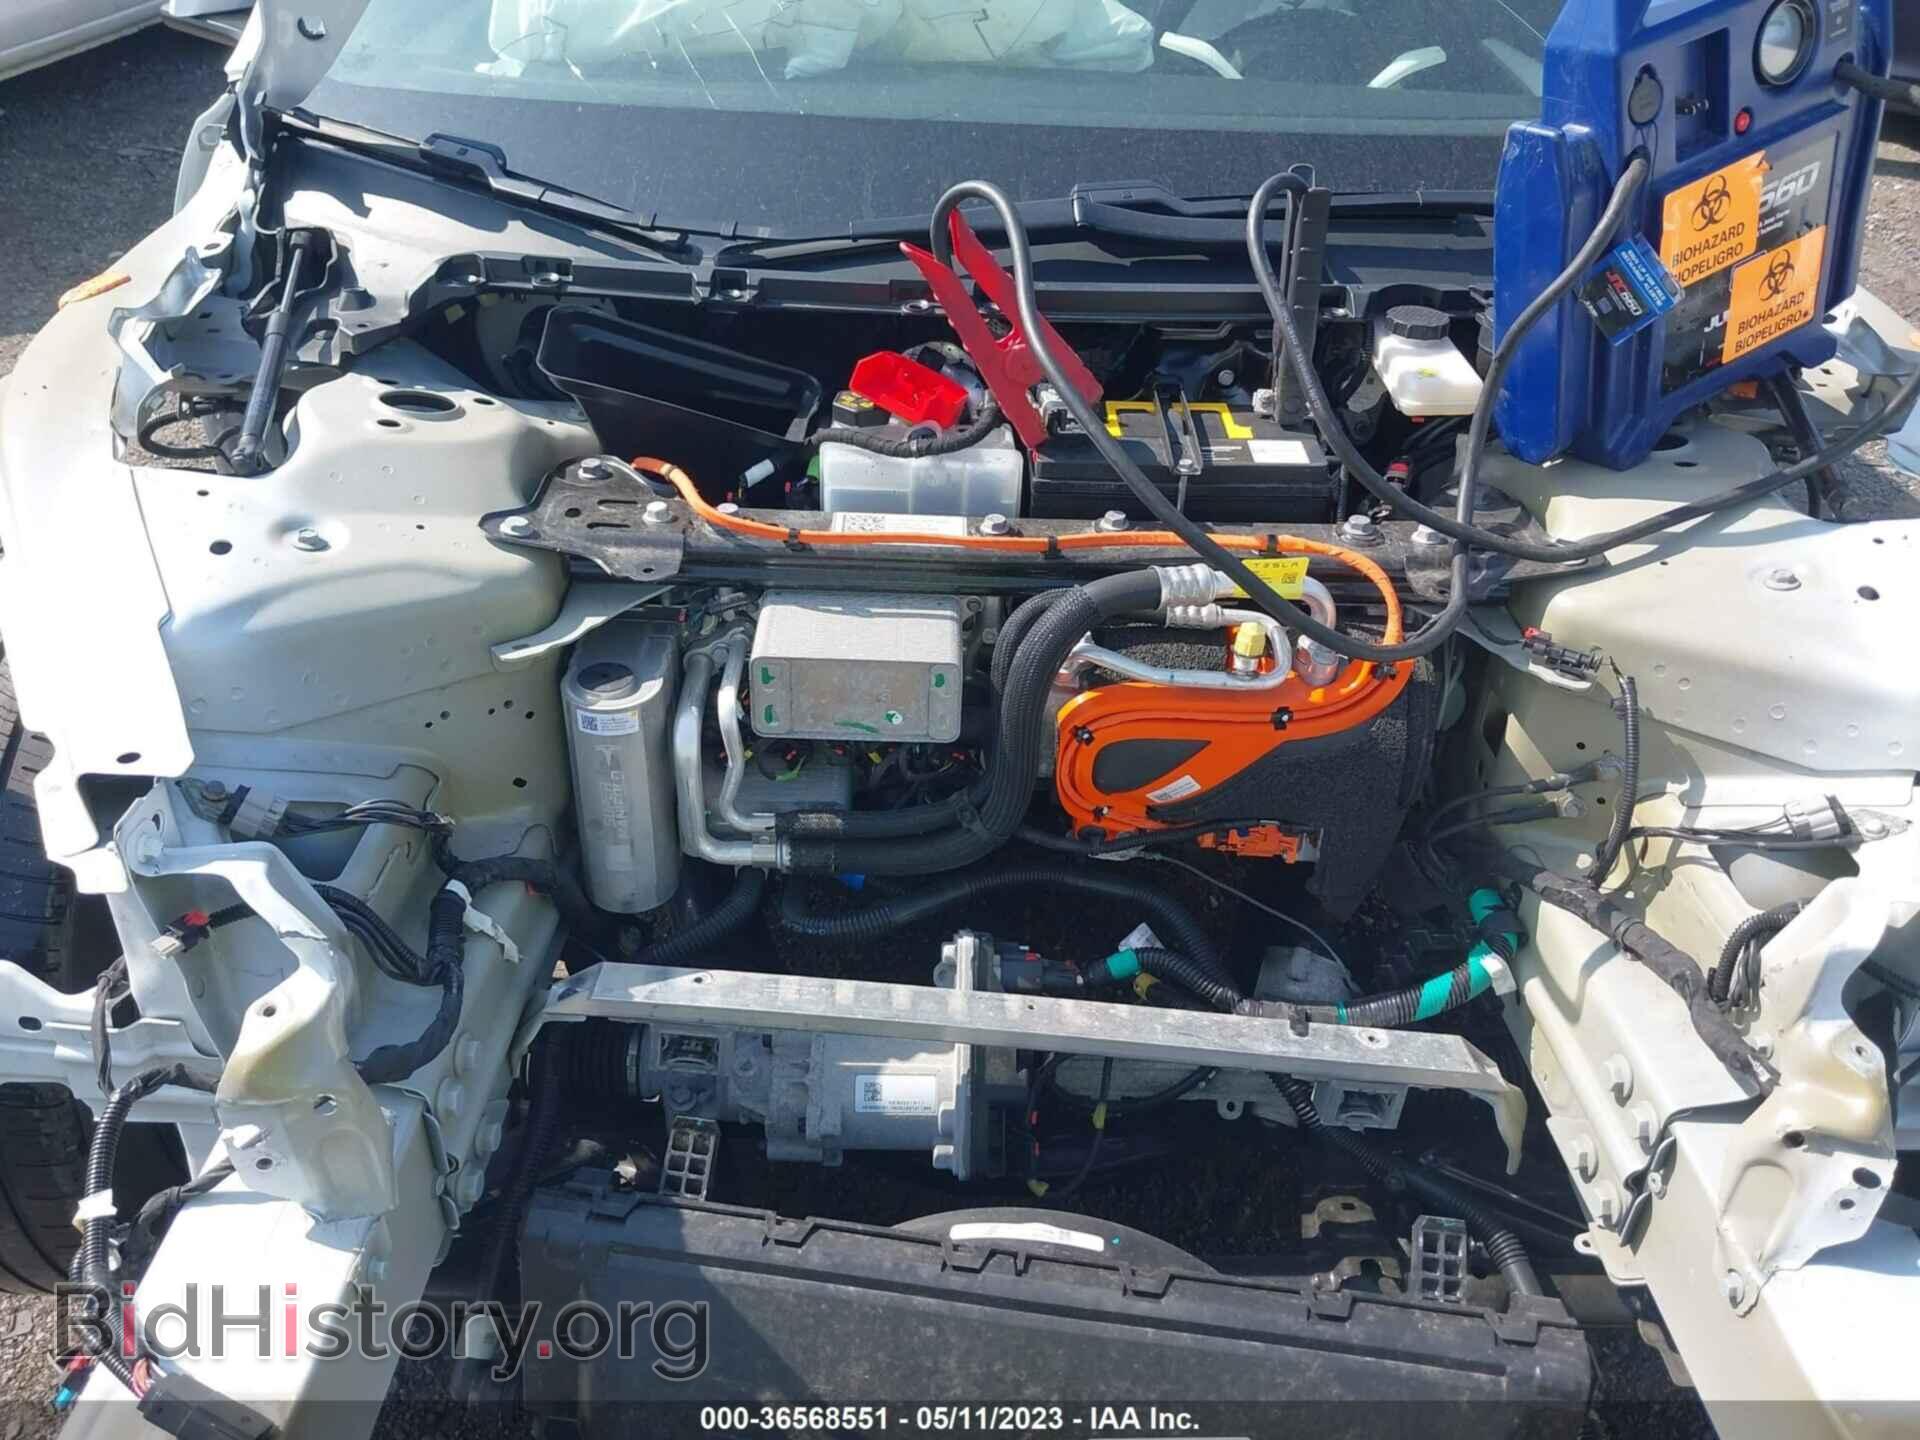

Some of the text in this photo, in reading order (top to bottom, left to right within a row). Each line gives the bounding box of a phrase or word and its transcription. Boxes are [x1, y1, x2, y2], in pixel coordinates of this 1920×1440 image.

[1672, 222, 1745, 268] BIOHAZARD
[1735, 310, 1802, 353] BIOPELIGRO
[1738, 291, 1805, 335] BIOHAZARD
